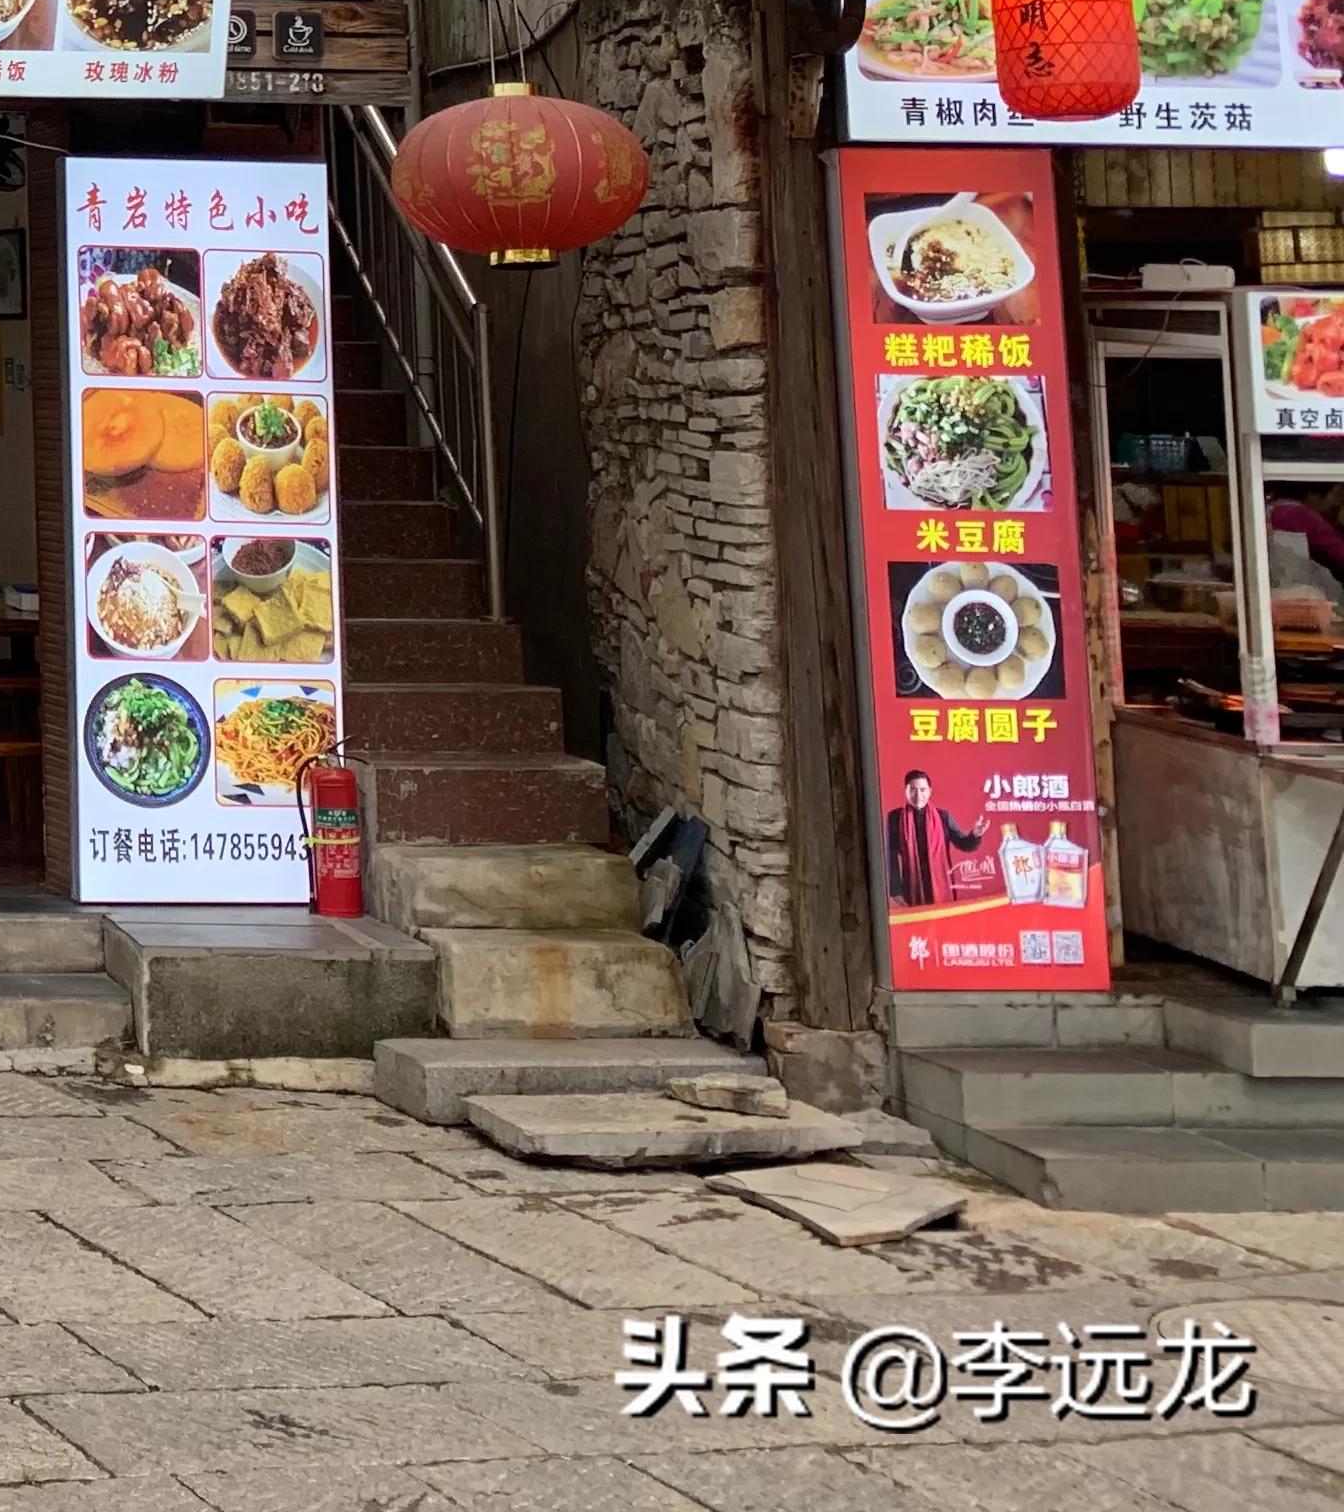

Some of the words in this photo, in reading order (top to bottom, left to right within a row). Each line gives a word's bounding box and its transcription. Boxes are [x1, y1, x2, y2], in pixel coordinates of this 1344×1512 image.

[84, 57, 180, 85] 玫瑰冰粉
[1118, 101, 1254, 132] 野生茨菇
[76, 182, 320, 235] 青岩特色小吃
[884, 333, 1033, 369] 糕粑稀饭
[1276, 408, 1344, 430] 真空卤
[916, 518, 1026, 556] 米豆腐
[908, 706, 1058, 744] 豆腐圆子
[983, 773, 1070, 800] 小郎酒
